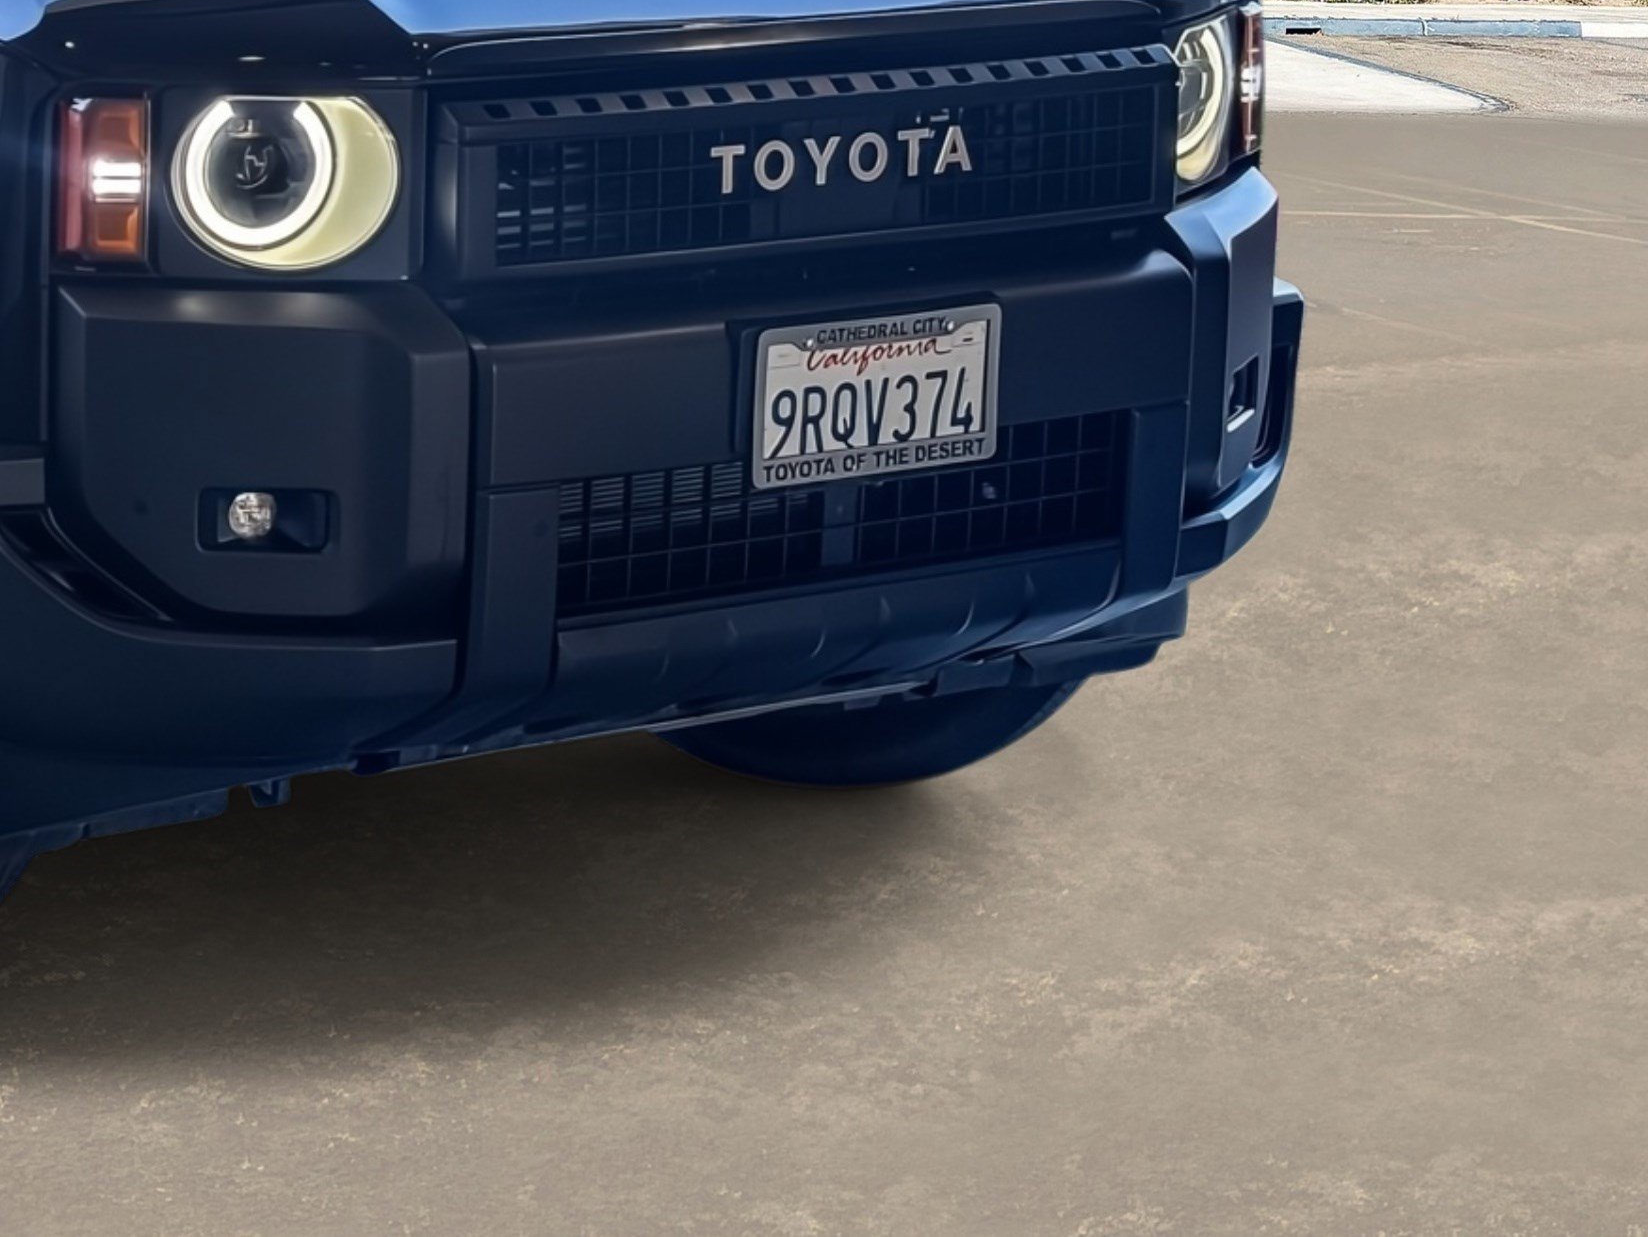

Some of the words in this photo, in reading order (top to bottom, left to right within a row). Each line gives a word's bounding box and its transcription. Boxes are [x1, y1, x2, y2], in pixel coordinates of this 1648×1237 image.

[709, 125, 973, 195] TOYOTA
[816, 321, 907, 345] CATHEDRAL
[912, 315, 947, 335] CITY
[806, 338, 952, 376] California
[765, 366, 974, 460] 9RQV374
[762, 458, 836, 484] TOYOTA
[842, 453, 868, 473] OF
[873, 447, 910, 468] THE
[914, 437, 986, 462] DESERT
